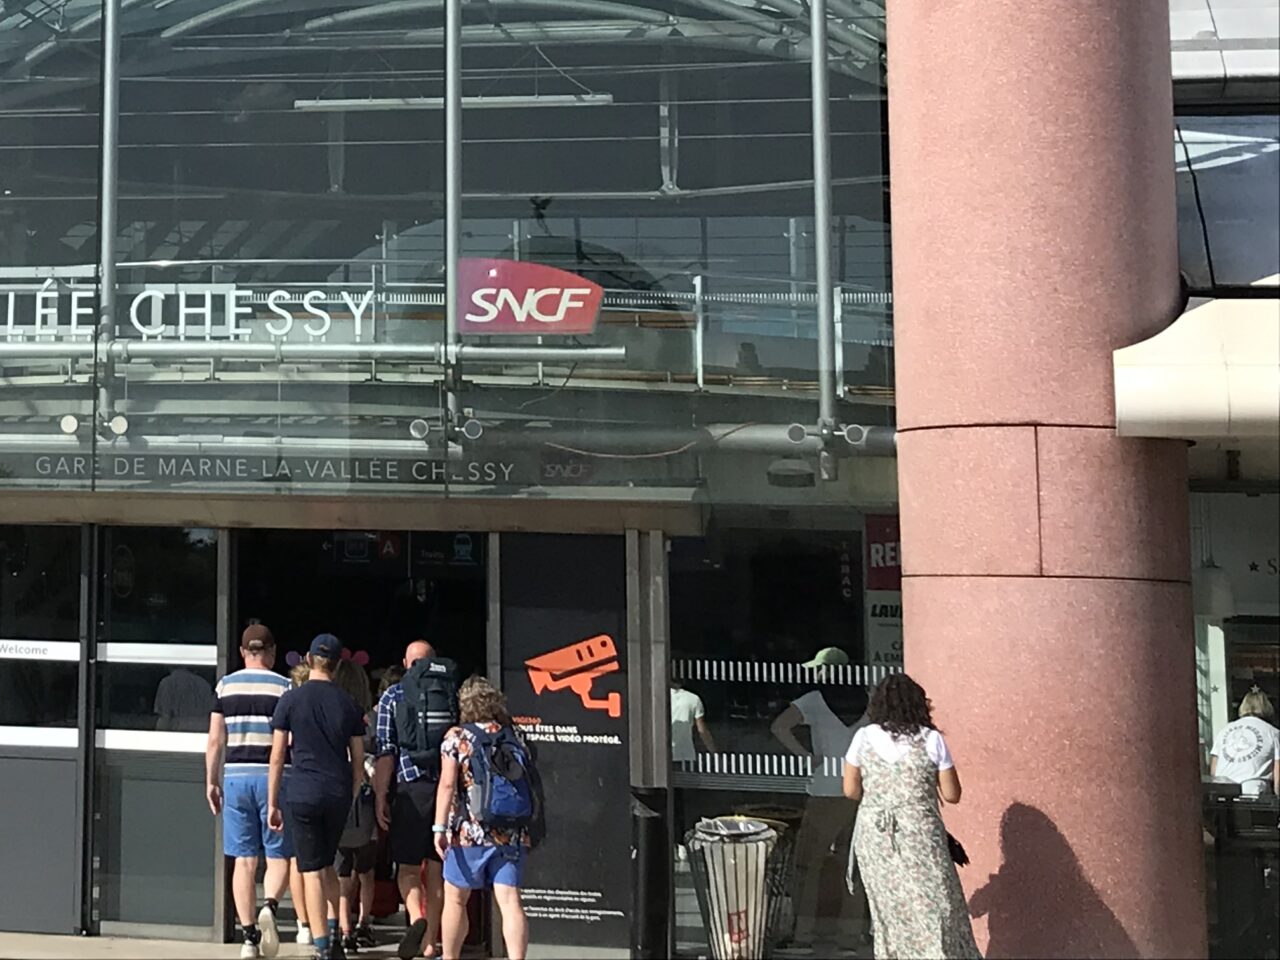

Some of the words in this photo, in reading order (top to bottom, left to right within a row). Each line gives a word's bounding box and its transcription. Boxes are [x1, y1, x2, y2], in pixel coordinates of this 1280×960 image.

[129, 288, 375, 336] CHESSY
[465, 286, 591, 324] SNCF
[36, 456, 101, 476] GARE
[114, 457, 145, 477] DE
[158, 458, 398, 480] MARNE-LA-VALLÉE
[412, 461, 514, 481] CHSSY
[544, 463, 589, 479] SNCF
[870, 543, 901, 568] RE
[870, 604, 903, 618] LAV
[535, 723, 554, 733] ÊTES
[555, 725, 578, 734] DANS
[556, 733, 582, 743] VIDÉO
[583, 734, 622, 745] PROTÉGÉ.
